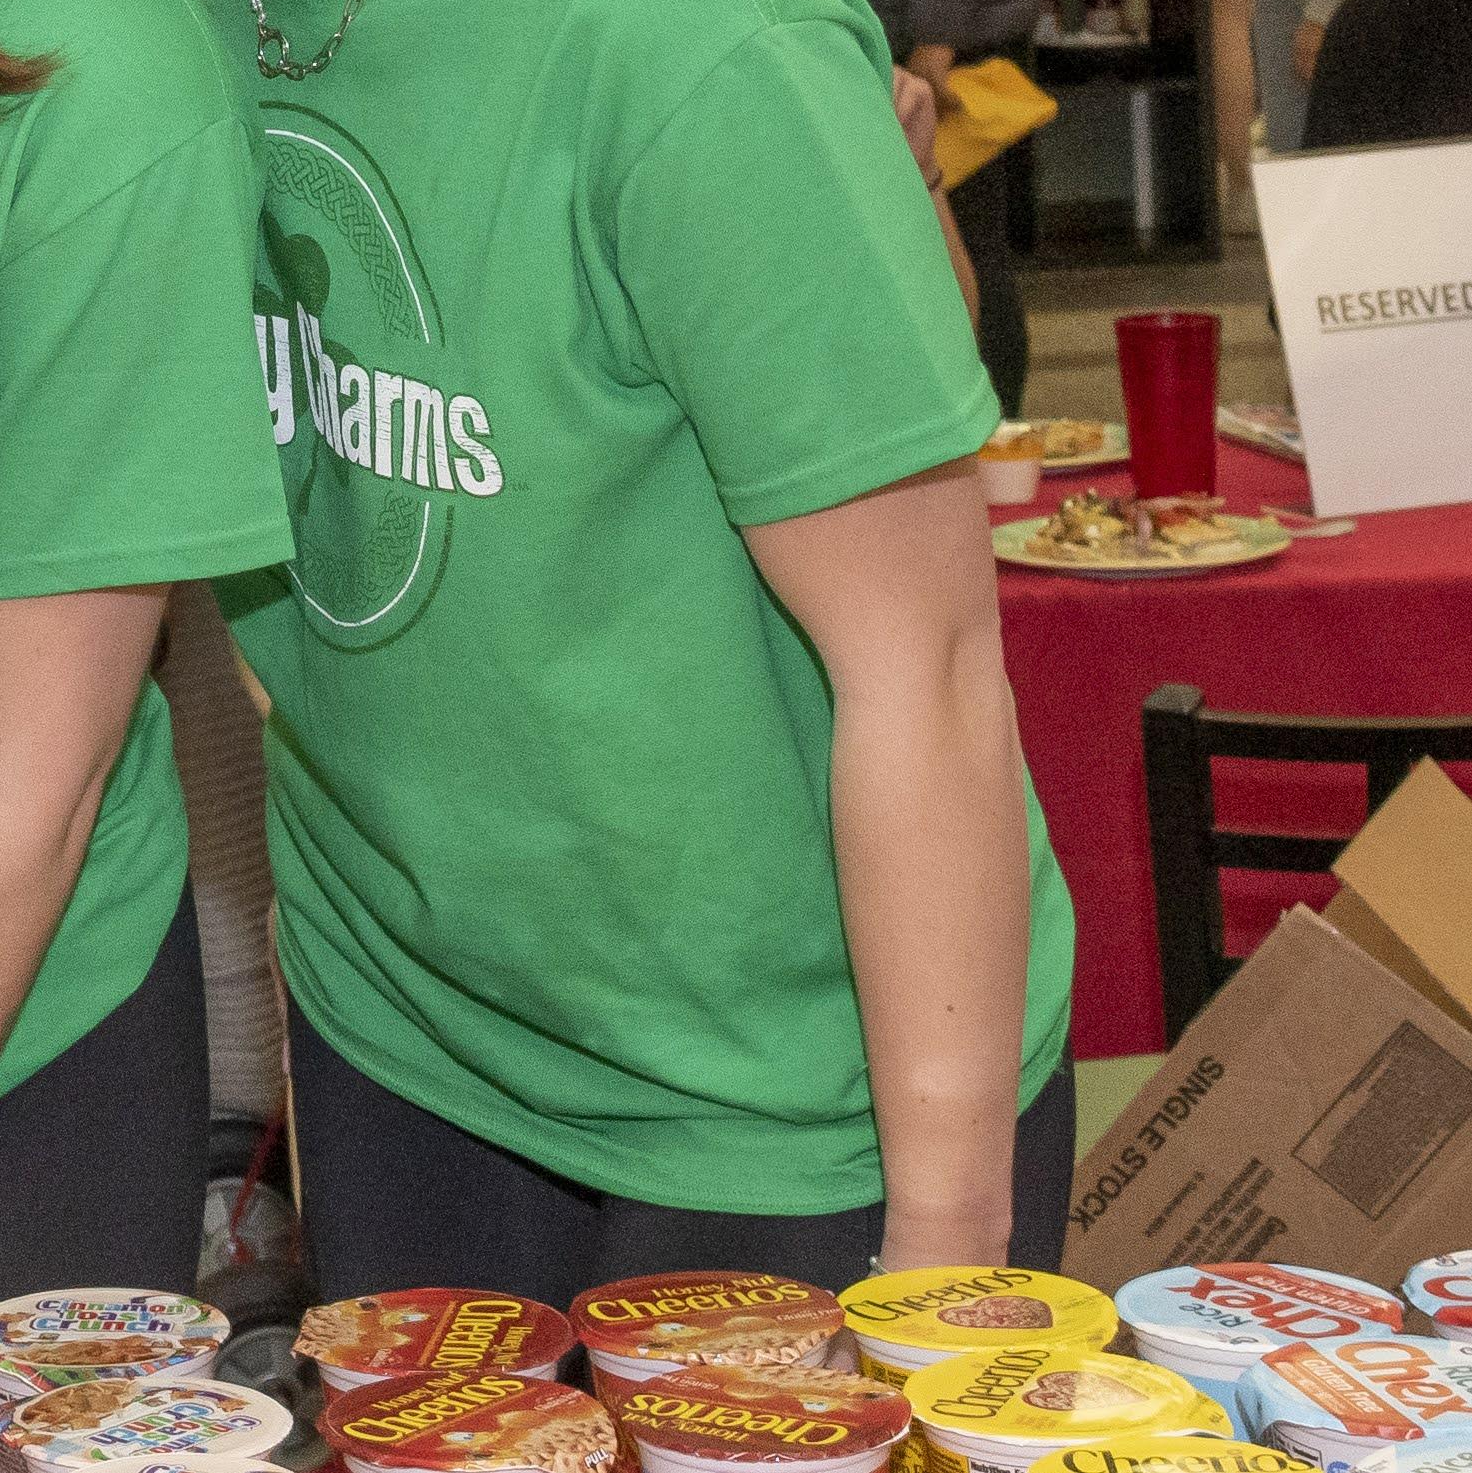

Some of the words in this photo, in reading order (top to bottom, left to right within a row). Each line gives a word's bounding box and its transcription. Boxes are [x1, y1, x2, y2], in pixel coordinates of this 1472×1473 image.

[1137, 1056, 1225, 1152] SINGLE
[1069, 1145, 1147, 1231] STOCK
[37, 1299, 186, 1313] Cinnamon
[587, 1283, 810, 1323] Cheerios
[652, 1283, 726, 1300] Honey
[734, 1274, 776, 1291] Nut
[846, 1268, 1033, 1322] Cheerios
[1167, 1277, 1361, 1339] Chex
[32, 1318, 174, 1333] Crunch
[58, 1310, 151, 1323] Toast
[431, 1300, 522, 1369] Cheerios
[1179, 1302, 1255, 1329] Rice
[372, 1385, 440, 1412] Honey
[434, 1370, 469, 1394] Nut
[931, 1349, 1051, 1419] Cheerios
[1336, 1340, 1472, 1420] Chex
[86, 1403, 213, 1445] Crunch
[343, 1376, 526, 1443] Cheerios
[621, 1411, 666, 1429] Nut
[623, 1393, 849, 1446] Cheerios
[672, 1419, 750, 1443] Honey
[584, 1447, 609, 1469] PULL
